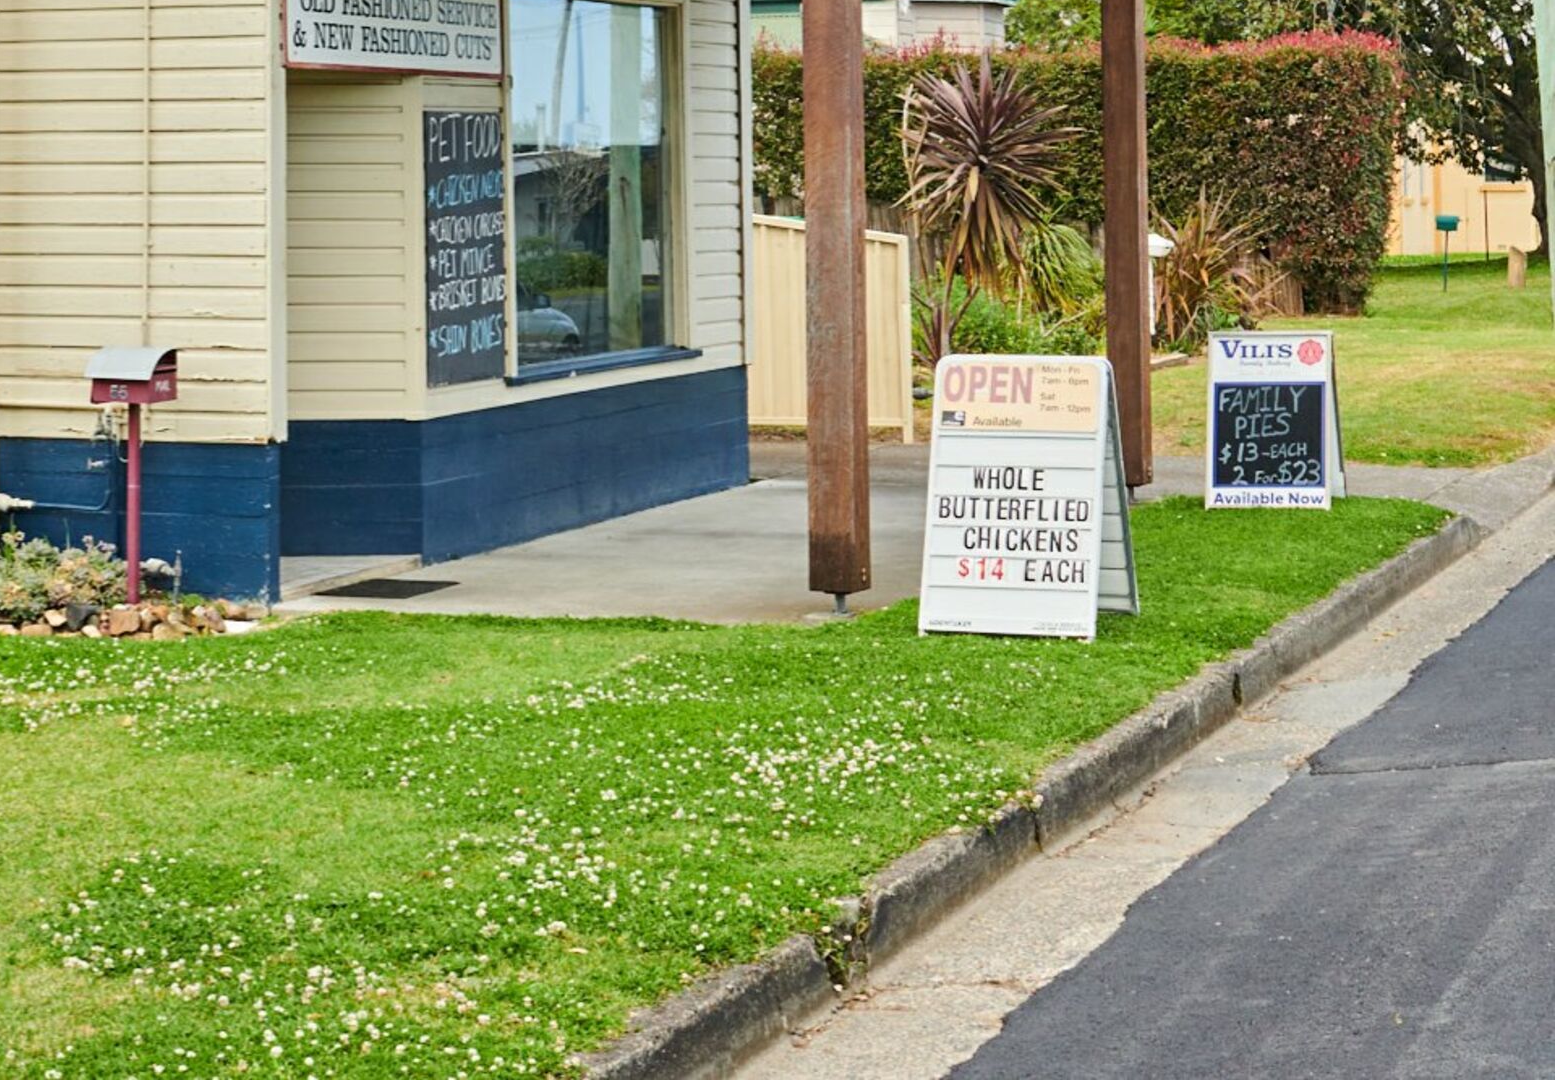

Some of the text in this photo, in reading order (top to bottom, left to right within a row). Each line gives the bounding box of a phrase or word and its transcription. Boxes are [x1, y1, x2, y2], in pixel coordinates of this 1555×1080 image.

[293, 20, 307, 47] &
[313, 22, 354, 51] NEW
[361, 26, 450, 58] FASHIONED
[429, 113, 501, 164] PET FOOD
[438, 243, 496, 278] PET MINCE
[438, 278, 478, 310] BRISKET
[470, 313, 503, 354] BONES
[943, 365, 1033, 404] OPEN
[1218, 386, 1307, 413] FAMILY
[973, 416, 1023, 427] Available
[1235, 413, 1292, 439] PIES
[1218, 442, 1259, 464] $13
[973, 466, 1045, 491] WHOLE
[1231, 465, 1248, 485] 2
[1278, 459, 1321, 486] $23
[938, 497, 1090, 522] BUTTERFLIED
[1214, 492, 1324, 505] Available Now
[963, 527, 1079, 553] CHICKENS
[957, 557, 1085, 583] $14 EACH
